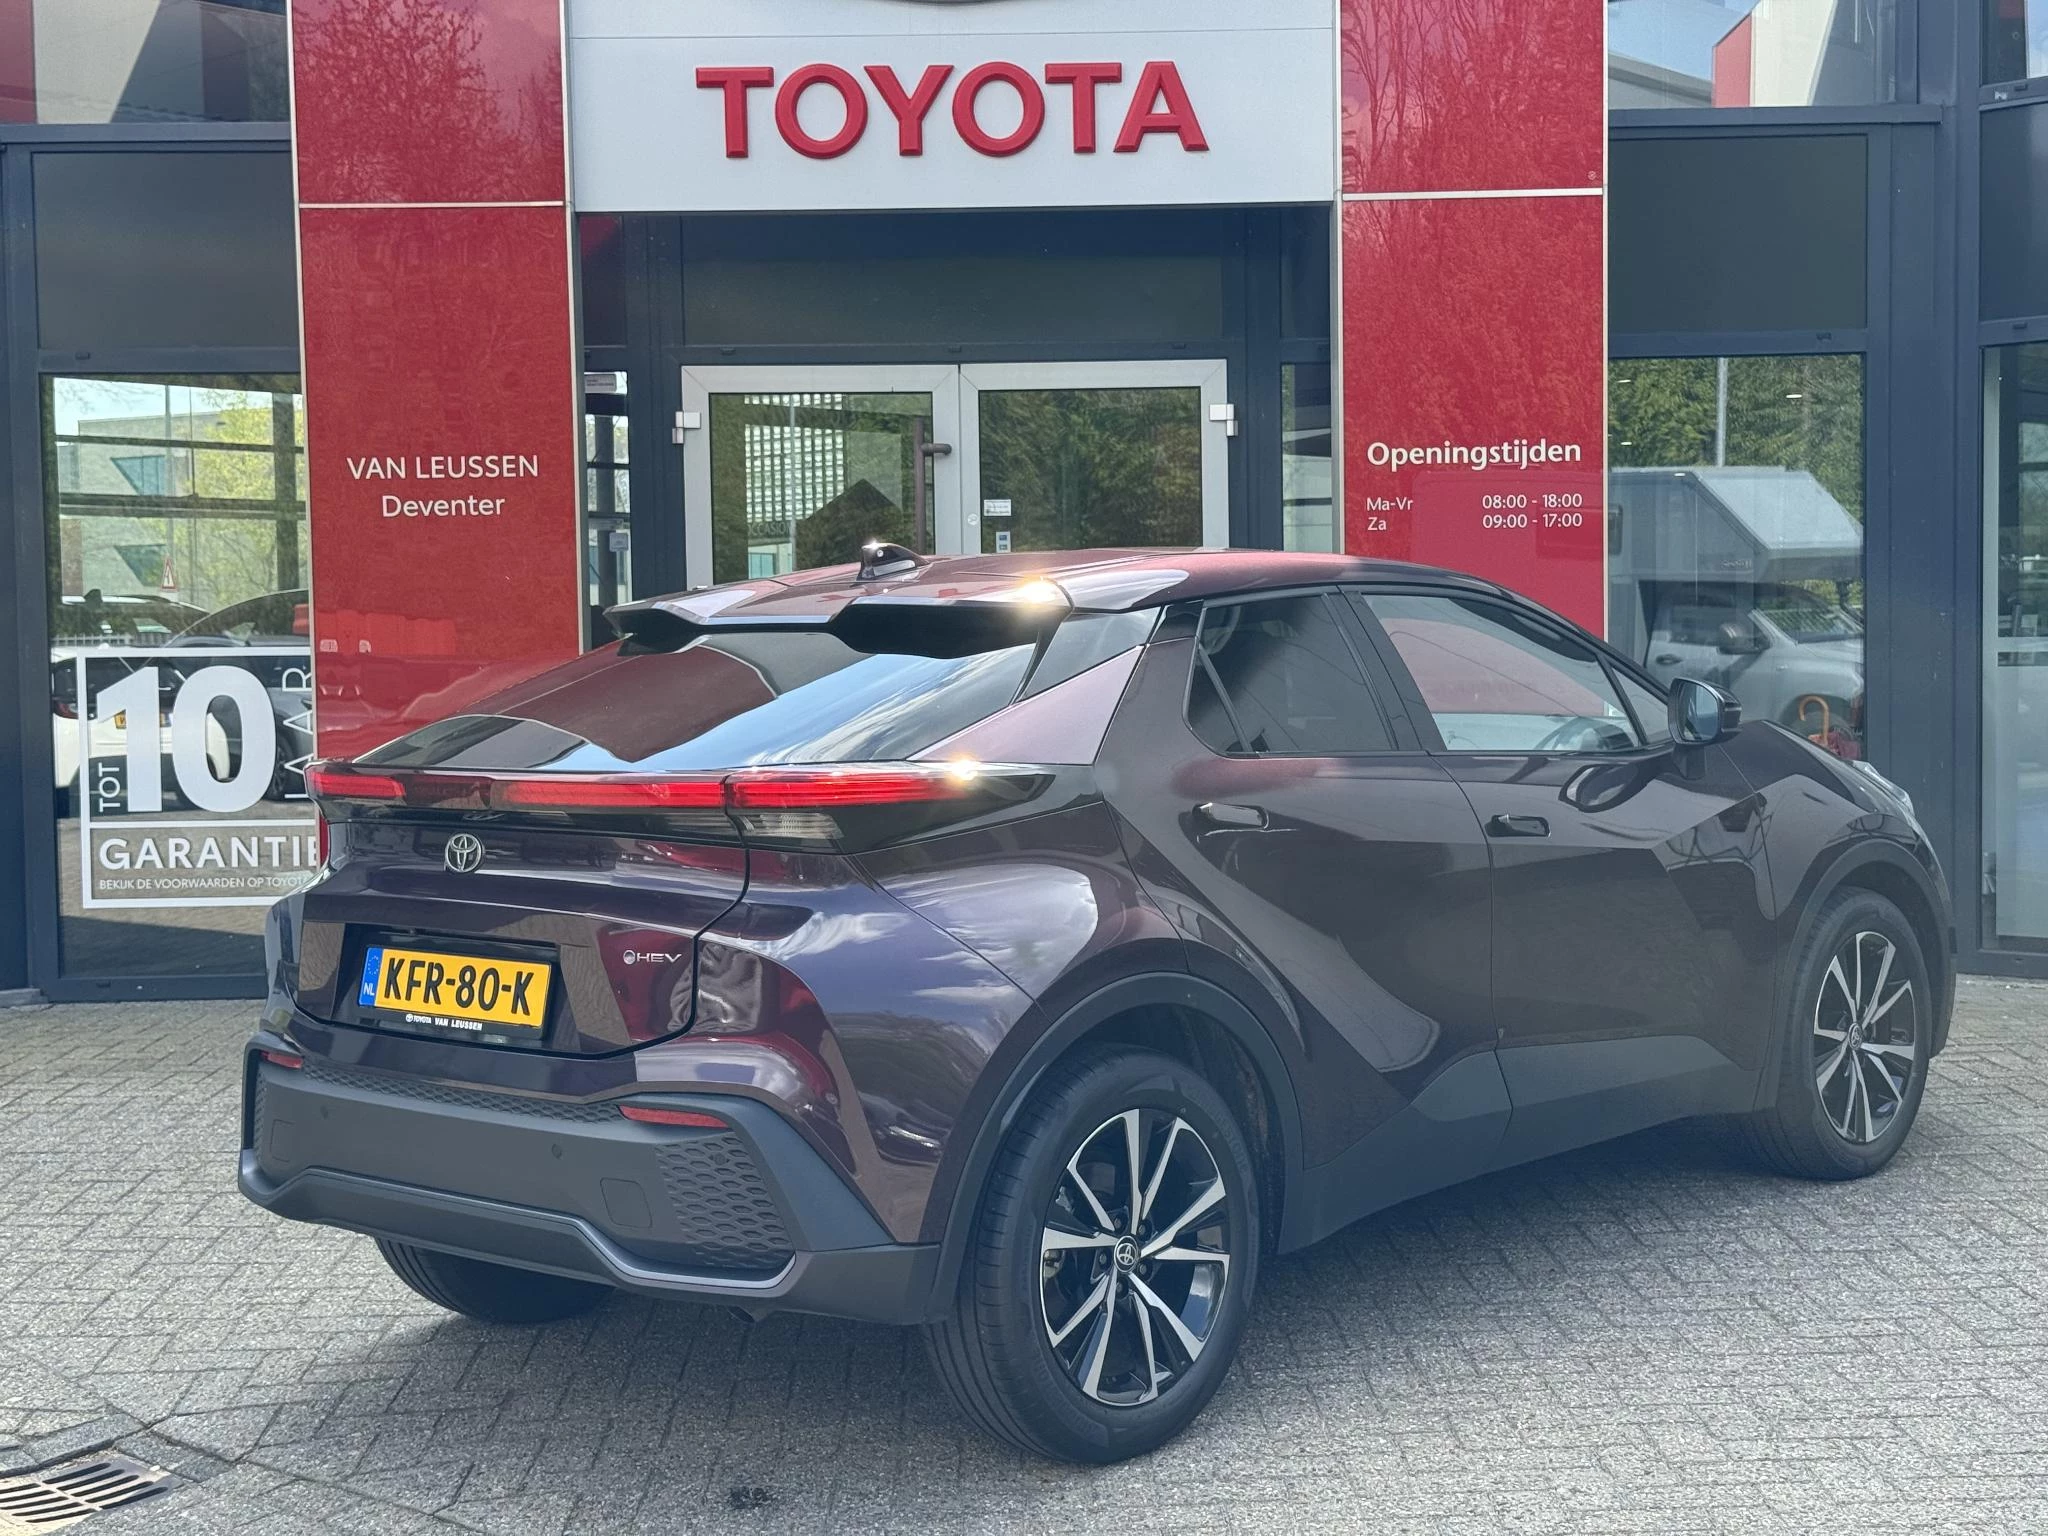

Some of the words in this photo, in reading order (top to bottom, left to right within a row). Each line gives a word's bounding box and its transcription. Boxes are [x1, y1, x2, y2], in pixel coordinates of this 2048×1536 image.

[695, 61, 1210, 159] TOYOTA
[1367, 438, 1581, 472] Openingstijden
[347, 457, 406, 480] VAN
[415, 455, 538, 479] LEUSSEN
[382, 495, 505, 518] Deventer
[1366, 497, 1413, 511] Ma-Vr
[1482, 495, 1527, 509] 08:00
[1542, 493, 1583, 508] 18:00
[1367, 517, 1387, 531] Za
[1482, 515, 1527, 528] 09:00
[1542, 513, 1583, 528] 17:00
[96, 665, 277, 813] 10
[98, 762, 121, 813] TOT
[100, 879, 135, 889] BEKIJK
[137, 879, 151, 889] DE
[155, 877, 245, 889] VOORWAARDEN
[247, 877, 264, 887] OP
[636, 953, 682, 964] HEV
[363, 981, 375, 997] NL
[385, 957, 534, 1016] KFR-80-K
[435, 1018, 448, 1026] VAN
[451, 1020, 482, 1030] LEUSSEN
